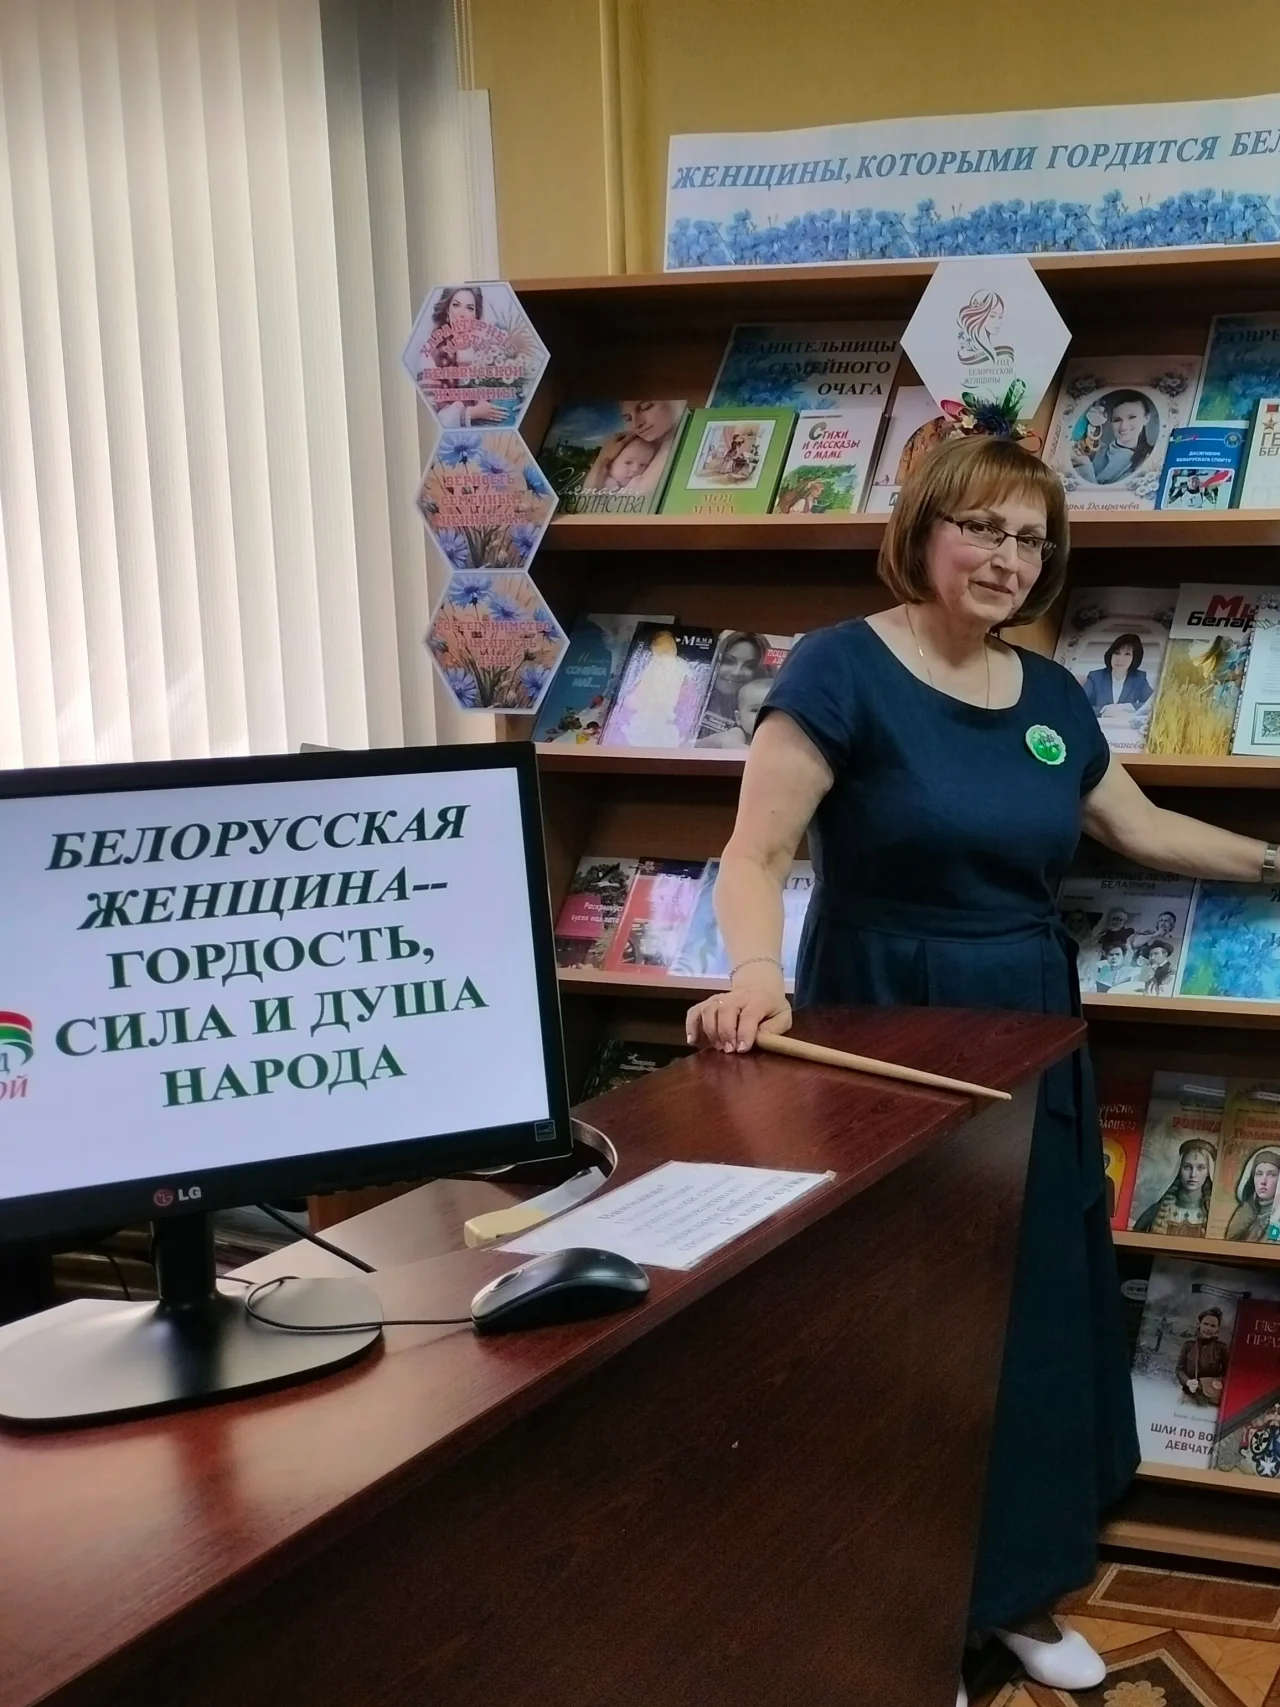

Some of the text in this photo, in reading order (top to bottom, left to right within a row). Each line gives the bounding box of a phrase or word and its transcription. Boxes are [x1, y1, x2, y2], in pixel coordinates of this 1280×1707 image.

[1047, 136, 1217, 174] ГОРДИТСЯ
[768, 358, 891, 376] СЕМЕЙНОГО
[818, 383, 884, 396] ОЧАГА
[813, 451, 843, 459] МАМЕ
[446, 475, 515, 486] ВЕРНОСТЬ
[1087, 501, 1140, 511] Домрачева
[438, 513, 527, 526] ЦЕННОСТЯМ
[436, 621, 551, 632] ГОСТЕПРИИМСТВО
[470, 639, 537, 649] ЩЕДРОСТЬ
[45, 804, 471, 872] БЕЛОРУССКАЯ
[107, 925, 436, 990] ГОРДОСТЬ,
[55, 976, 489, 1057] СИЛА И ДУША
[160, 1043, 407, 1108] НАРОДА
[178, 1186, 202, 1202] LG
[717, 1216, 741, 1226] 15
[1151, 1422, 1176, 1436] ШЛИ
[1180, 1427, 1195, 1439] ПО
[1165, 1439, 1214, 1456] ДЕВЧАТА
